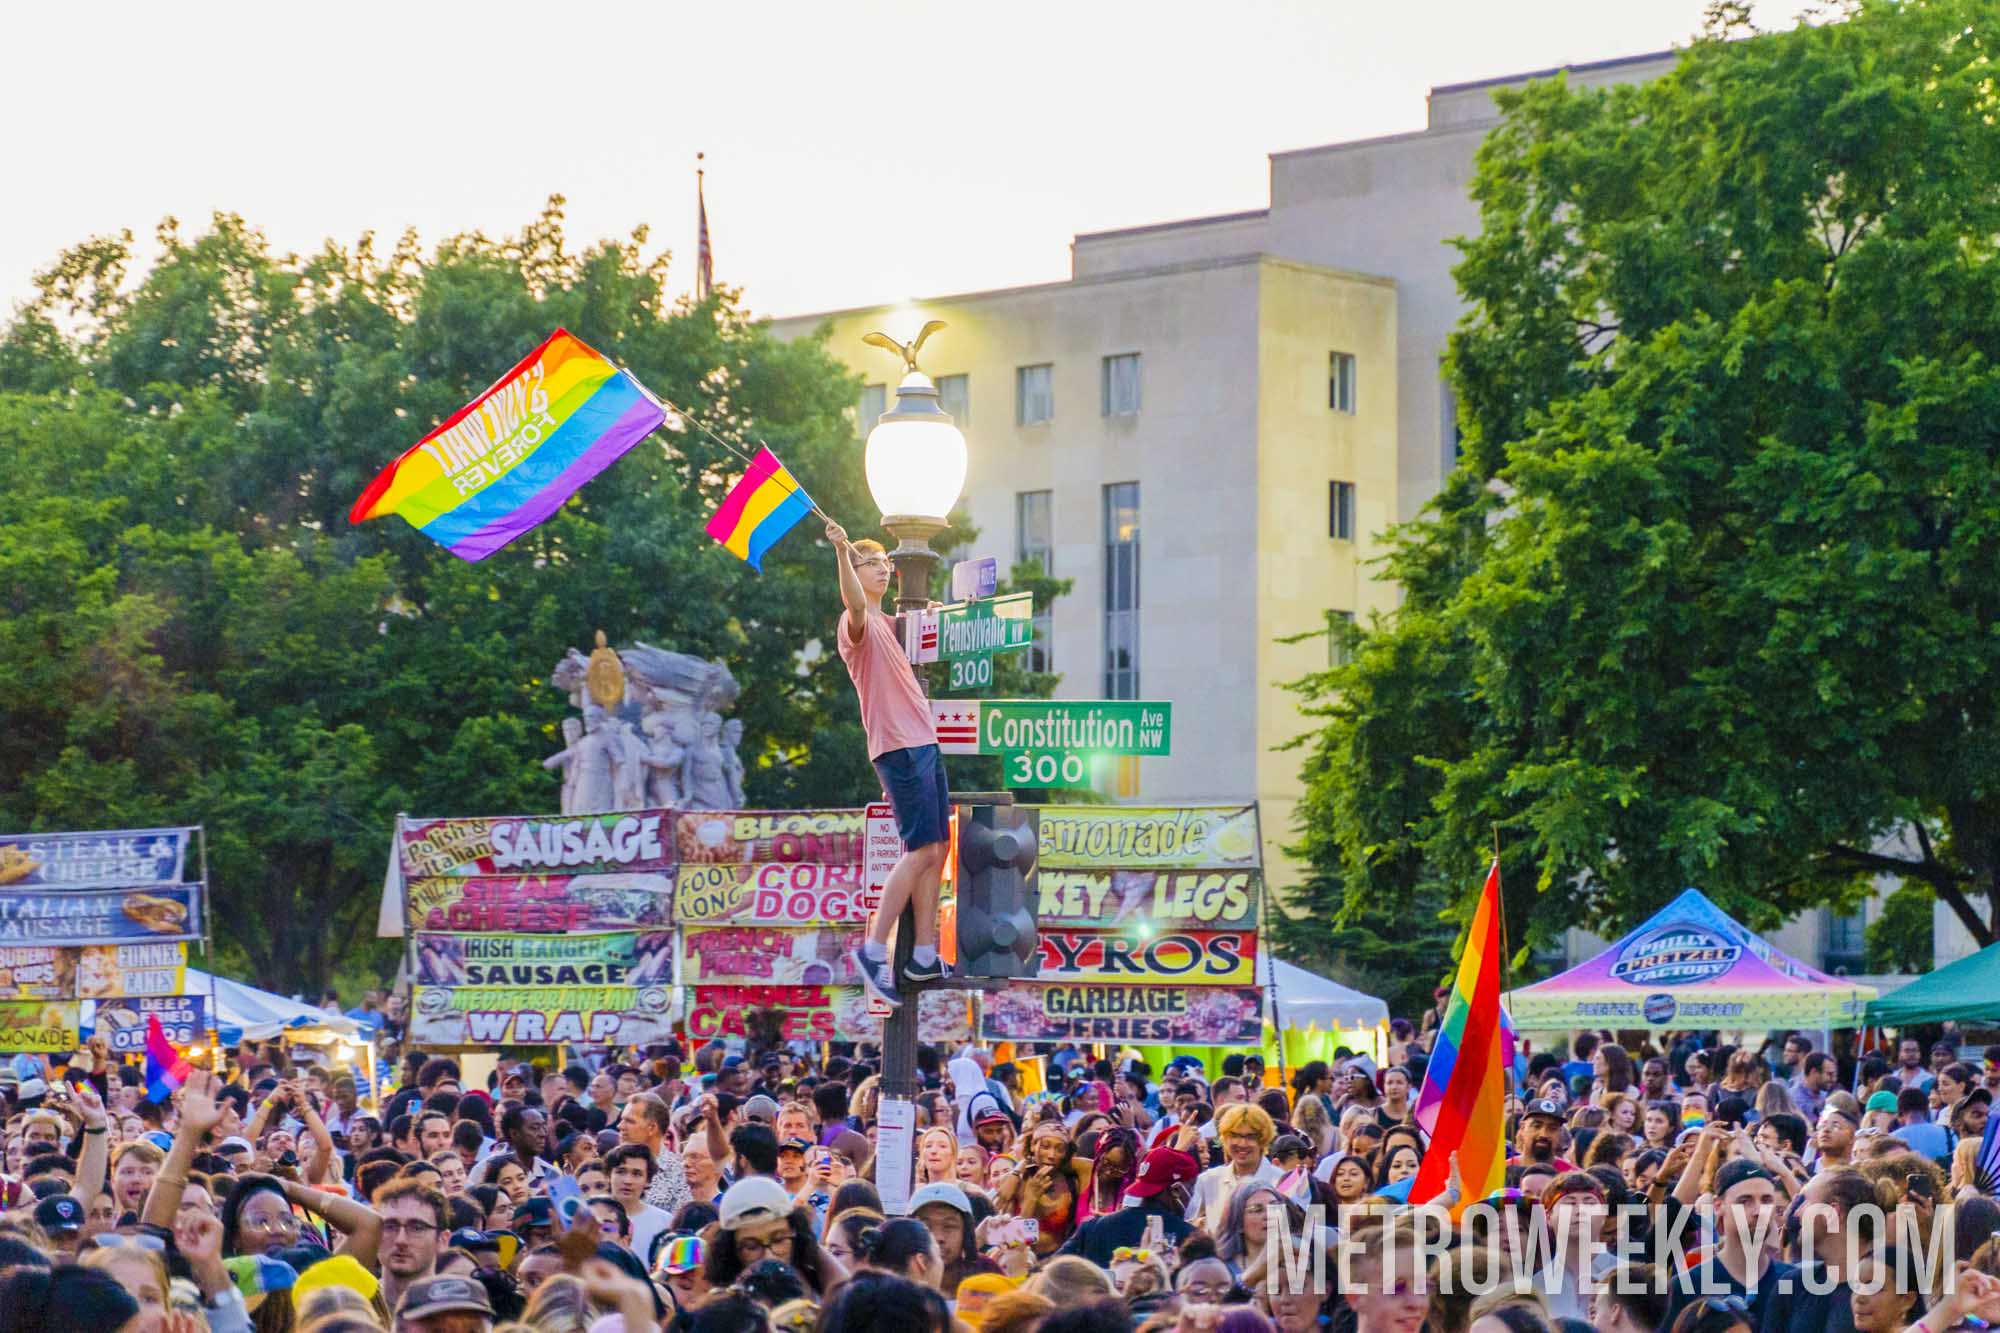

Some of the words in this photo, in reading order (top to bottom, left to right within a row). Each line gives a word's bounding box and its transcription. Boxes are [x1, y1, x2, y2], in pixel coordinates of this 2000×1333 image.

[943, 608, 1006, 653] Pennsylvania
[1011, 623, 1024, 642] NW
[952, 659, 990, 687] 300
[987, 708, 1133, 748] Constitution
[1140, 709, 1163, 727] Ave
[1140, 729, 1163, 748] NW
[1012, 754, 1084, 784] 300
[871, 836, 898, 845] STANDING
[880, 824, 890, 832] NO
[28, 839, 139, 860] STEAK
[151, 837, 174, 858] &
[407, 822, 466, 863] Polish
[471, 820, 489, 837] &
[491, 816, 661, 868] SAUSAGE
[39, 859, 159, 881] CHEESE
[417, 841, 491, 877] Italian
[680, 866, 736, 897] FOOT
[680, 885, 741, 918] LONG
[1152, 873, 1249, 921] LEGS
[464, 939, 514, 958] IRISH
[686, 928, 794, 959] FRENCH
[1039, 934, 1240, 975] YROS
[1638, 934, 1710, 956] PHILLY
[699, 952, 774, 979] FRIES
[1626, 949, 1733, 973] PRETZEL
[1633, 963, 1725, 983] FACTORY
[466, 965, 625, 985] SAUSAGE
[140, 998, 192, 1011] DEEP
[451, 988, 637, 1011] MEDITERRANEAN
[696, 984, 830, 1010] FUNNEL
[1046, 987, 1185, 1013] GARBAGE
[115, 1027, 192, 1047] OROS
[467, 1010, 623, 1042] WRAP
[690, 1008, 836, 1041] CAES
[1072, 1017, 1171, 1040] FRIES
